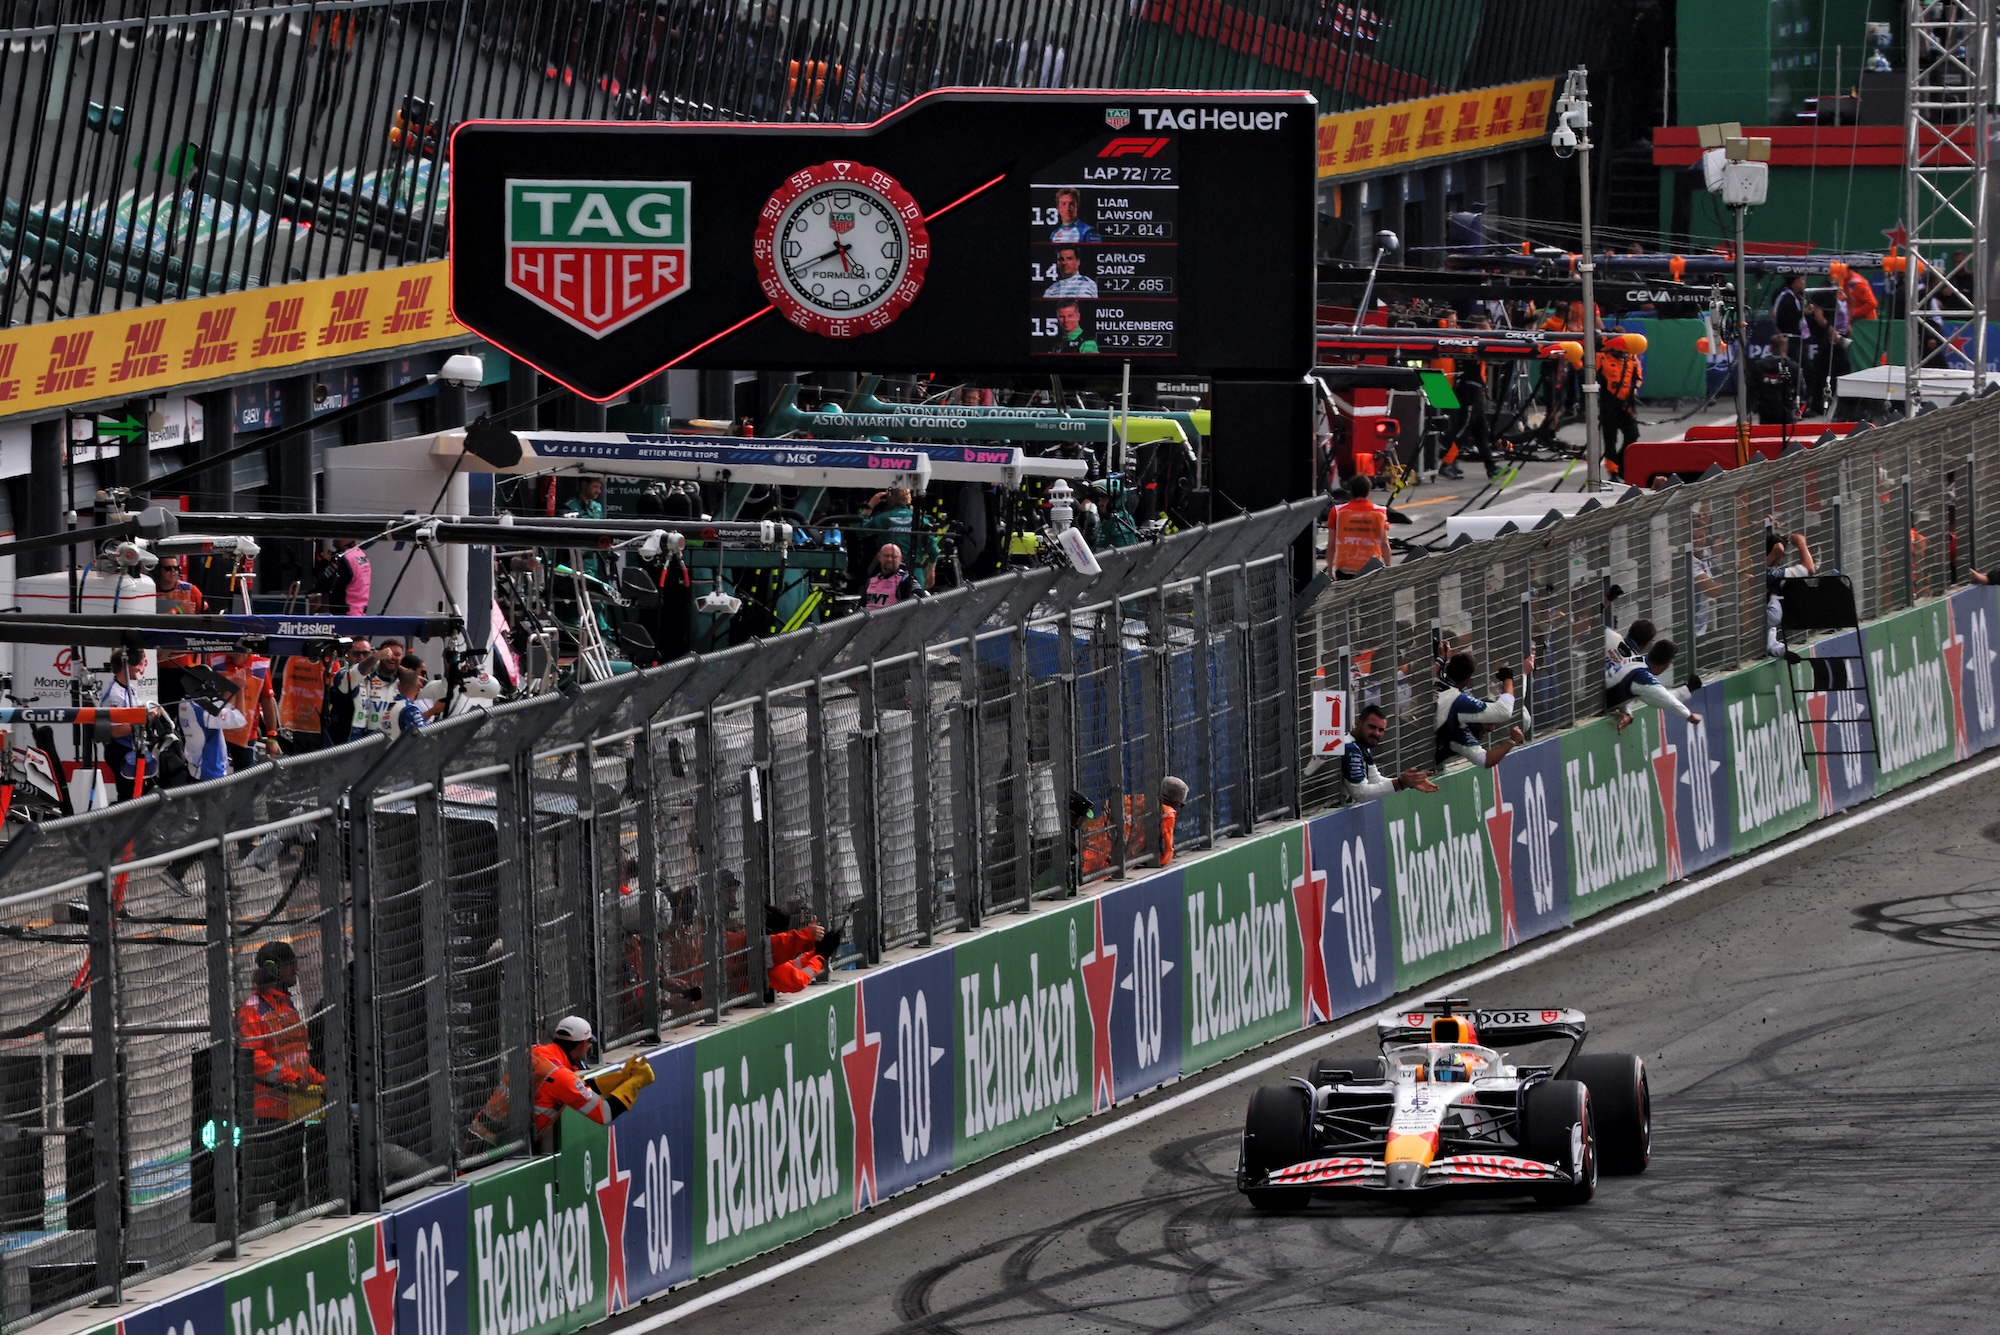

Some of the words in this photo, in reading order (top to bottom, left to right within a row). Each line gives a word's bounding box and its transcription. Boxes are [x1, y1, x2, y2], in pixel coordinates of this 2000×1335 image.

[1106, 118, 1130, 128] HEUER
[1451, 101, 1480, 143] DHL
[1484, 95, 1513, 137] DHL
[1379, 112, 1410, 157] DHL
[1416, 105, 1444, 149] DHL
[1343, 118, 1375, 164] DHL
[790, 170, 812, 188] 55
[871, 172, 893, 190] 05
[1084, 167, 1119, 180] LAP
[762, 198, 781, 219] 50
[903, 202, 919, 219] 10
[1097, 198, 1129, 208] LIAM
[522, 192, 672, 238] TAG
[1031, 208, 1059, 225] 13
[1097, 211, 1153, 220] LAWSON
[755, 239, 766, 259] 45
[916, 243, 927, 259] 15
[1096, 254, 1146, 263] CARLOS
[1031, 263, 1059, 281] 14
[1096, 265, 1135, 275] SAINZ
[1793, 266, 1830, 275] WORLD
[518, 253, 678, 324] HEUER
[762, 279, 778, 299] 40
[901, 281, 919, 302] 20
[1104, 279, 1164, 291] +17.685
[382, 276, 434, 334] DHL
[1096, 309, 1125, 318] NICO
[317, 287, 370, 346] DHL
[791, 312, 811, 328] 35
[870, 312, 891, 329] 25
[251, 297, 307, 358] DHL
[830, 325, 850, 337] 30
[1031, 318, 1059, 336] 15
[1096, 321, 1174, 331] HULKENBERG
[182, 307, 239, 369] DHL
[1104, 335, 1164, 347] +19.572
[1438, 339, 1479, 347] ORACLE
[1505, 332, 1545, 340] ORACLE
[109, 319, 168, 383] DHL
[35, 331, 96, 395] DHL
[1157, 382, 1209, 392] Einhell
[812, 415, 854, 426] ASTON
[857, 416, 904, 427] MARTIN
[909, 417, 968, 429] aramco
[1059, 420, 1086, 430] arm
[562, 445, 620, 455] CASTORE
[639, 449, 667, 457] BETTER
[668, 450, 692, 458] NEVER
[695, 451, 719, 459] STOPS
[786, 453, 817, 464] MSC
[976, 451, 1009, 463] BWT
[881, 458, 912, 469] BWT
[277, 622, 336, 636] Airtasker
[1871, 637, 1947, 774] Heineken
[21, 709, 65, 722] Gulf
[1728, 684, 1811, 834] Heineken
[1567, 743, 1657, 896] Heineken
[1390, 804, 1491, 964] Heineken
[1188, 872, 1290, 1046] Heineken
[961, 952, 1079, 1139] Heineken
[1133, 905, 1163, 1070] 0.0
[703, 1042, 839, 1246] Heineken
[899, 989, 931, 1165] 0.0
[1278, 1157, 1365, 1183] HUGO
[1451, 1155, 1546, 1178] HUGO
[474, 1182, 594, 1335] Heineken
[646, 1134, 672, 1276] 0.0
